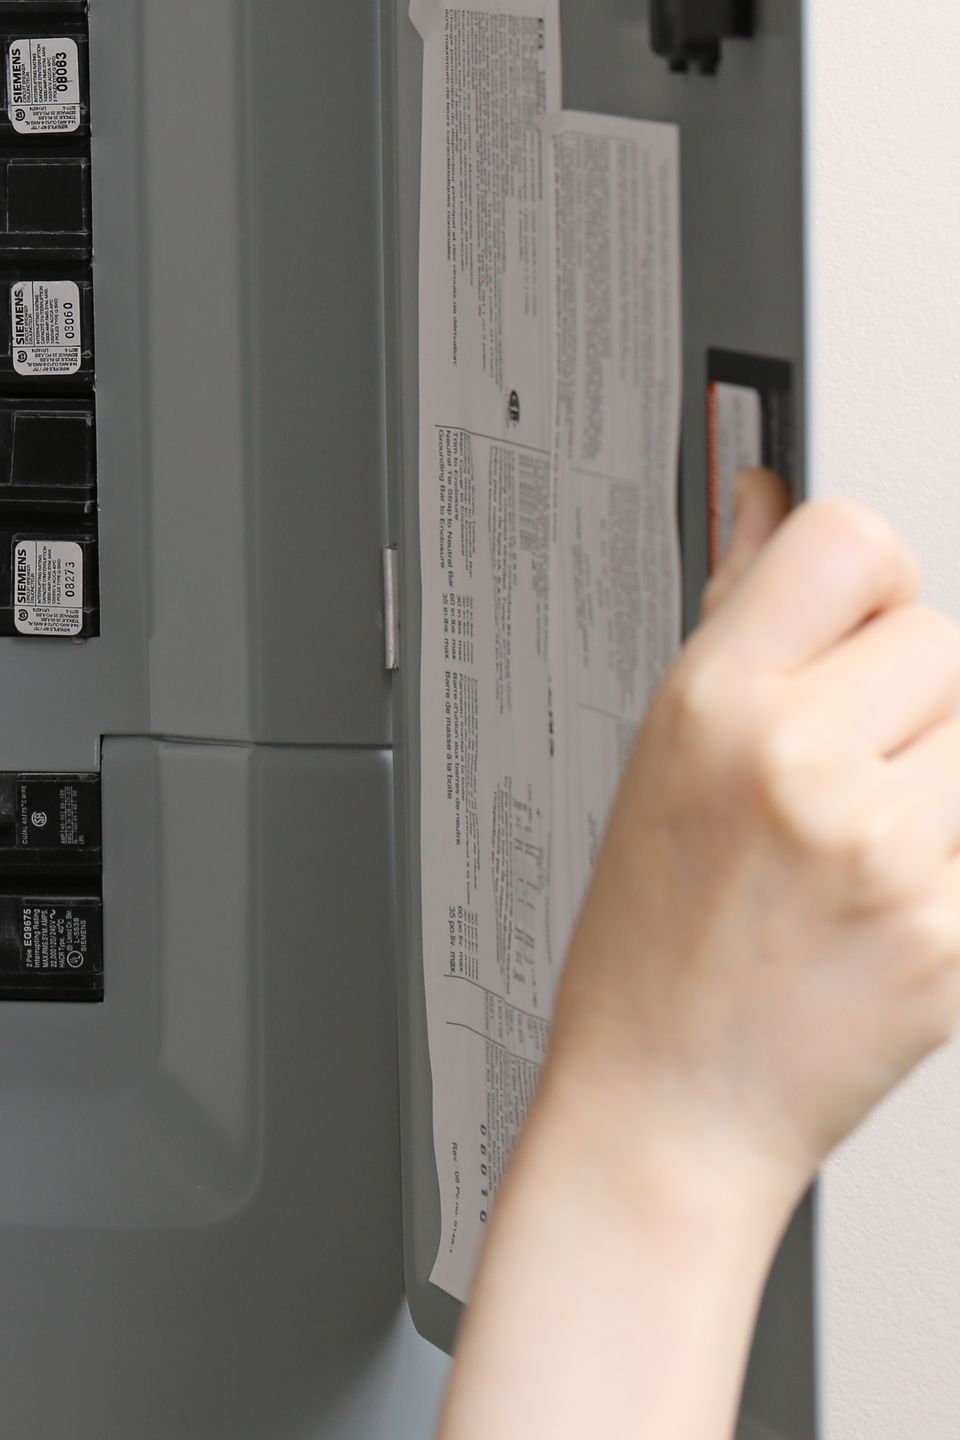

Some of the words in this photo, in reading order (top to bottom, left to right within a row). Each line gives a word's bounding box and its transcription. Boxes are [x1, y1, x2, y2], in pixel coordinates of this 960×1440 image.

[11, 48, 23, 104] SIEMENS
[14, 290, 25, 345] SIEMENS
[438, 429, 446, 482] Grounding
[445, 430, 453, 467] Neutral
[439, 505, 446, 516] to
[446, 488, 454, 516] Strap
[446, 518, 453, 529] to
[17, 549, 27, 604] SIEMENS
[23, 908, 32, 946] EQ9675
[33, 908, 41, 930] Rating
[33, 931, 41, 968] Interrupting
